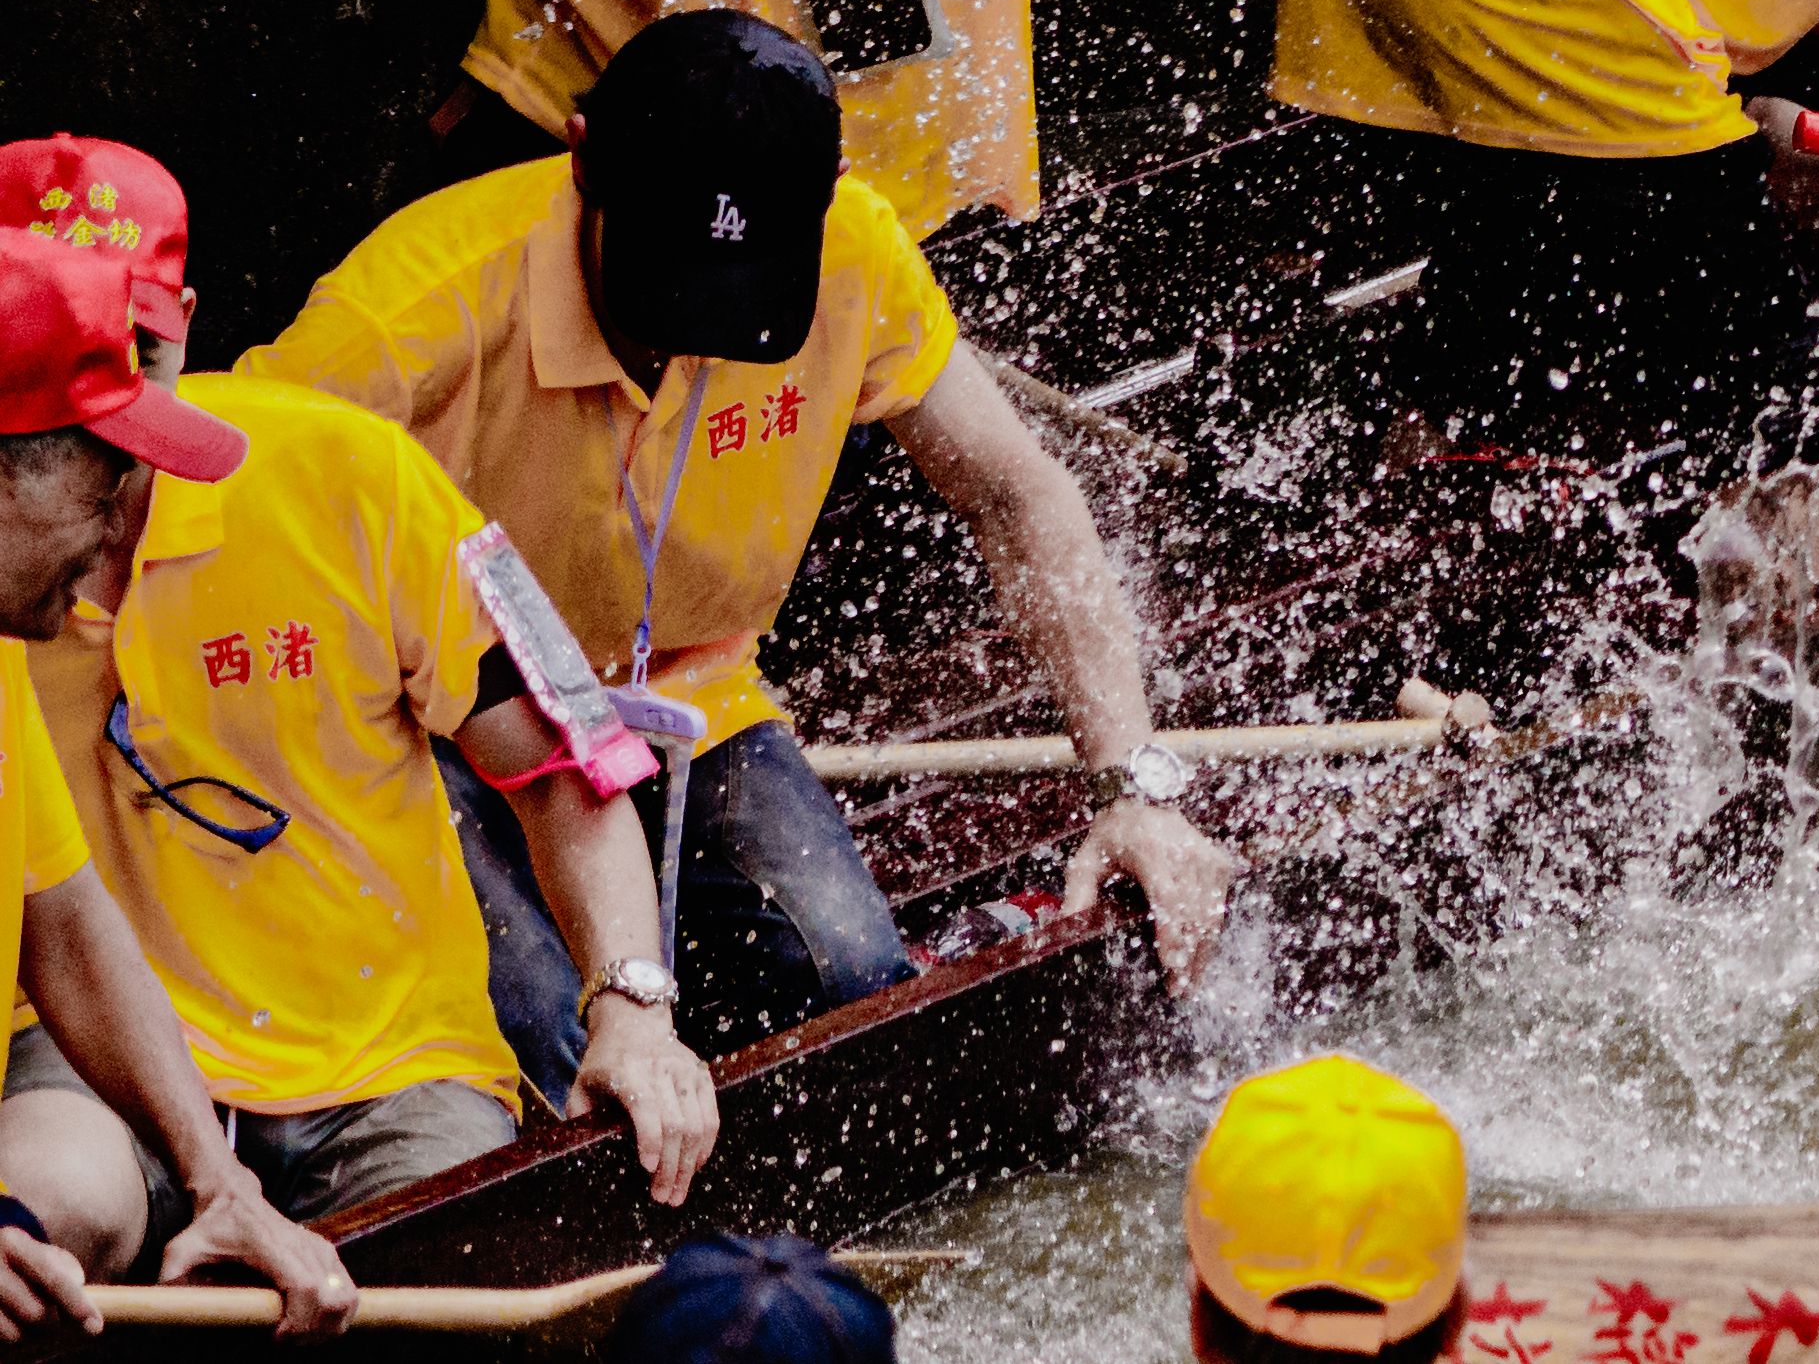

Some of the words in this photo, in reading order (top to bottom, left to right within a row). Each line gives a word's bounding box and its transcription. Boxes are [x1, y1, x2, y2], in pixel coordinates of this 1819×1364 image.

[38, 183, 119, 213] 西渚
[710, 193, 747, 241] LA
[706, 384, 807, 460] 西渚
[201, 618, 319, 689] 西渚
